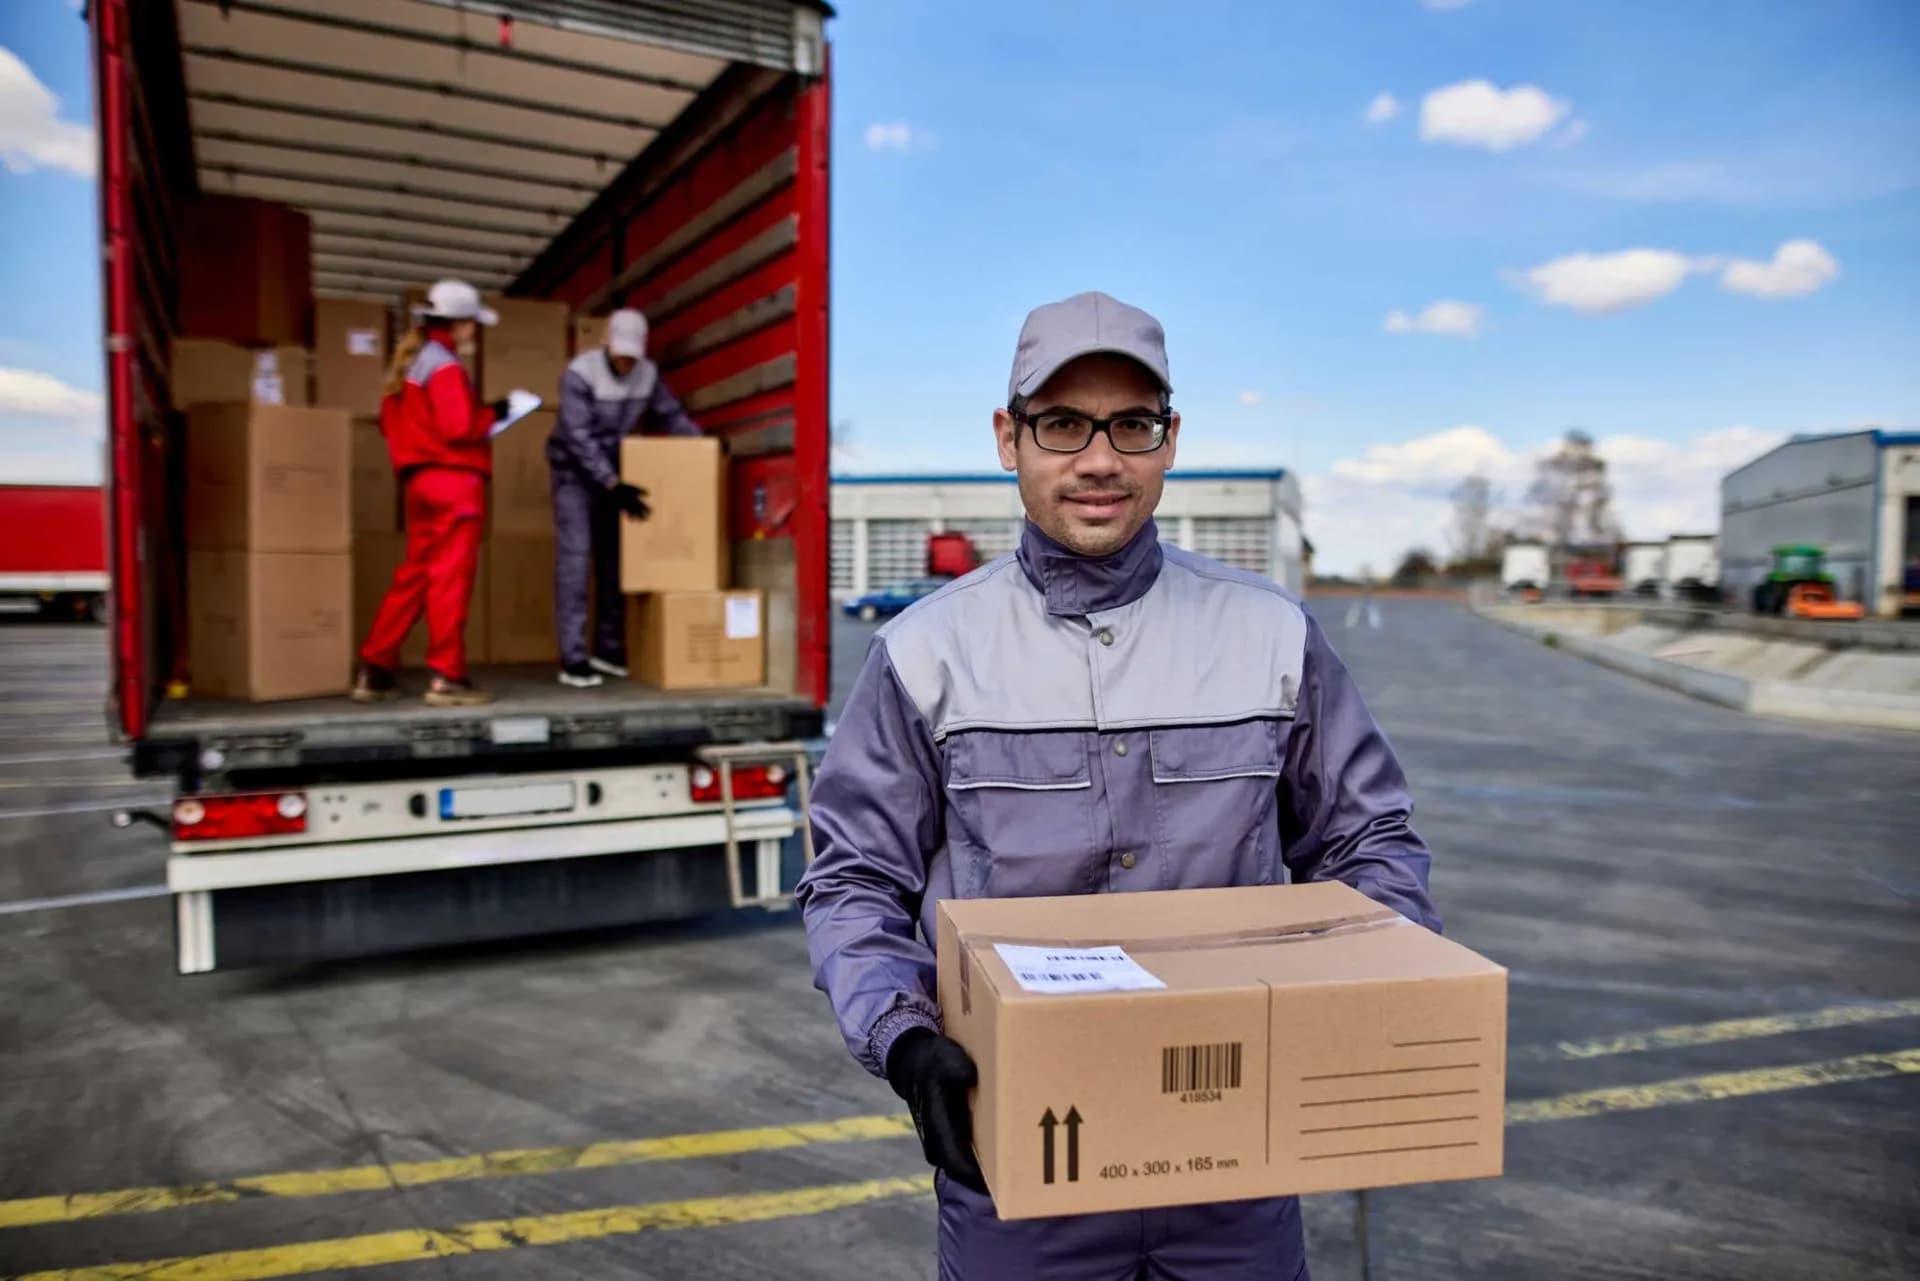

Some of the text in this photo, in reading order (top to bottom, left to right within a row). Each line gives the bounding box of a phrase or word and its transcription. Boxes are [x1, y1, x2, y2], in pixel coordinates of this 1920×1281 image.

[1099, 1164, 1128, 1179] 400
[1142, 1160, 1170, 1176] 300
[1187, 1156, 1213, 1172] 165
[1216, 1158, 1239, 1169] mm
